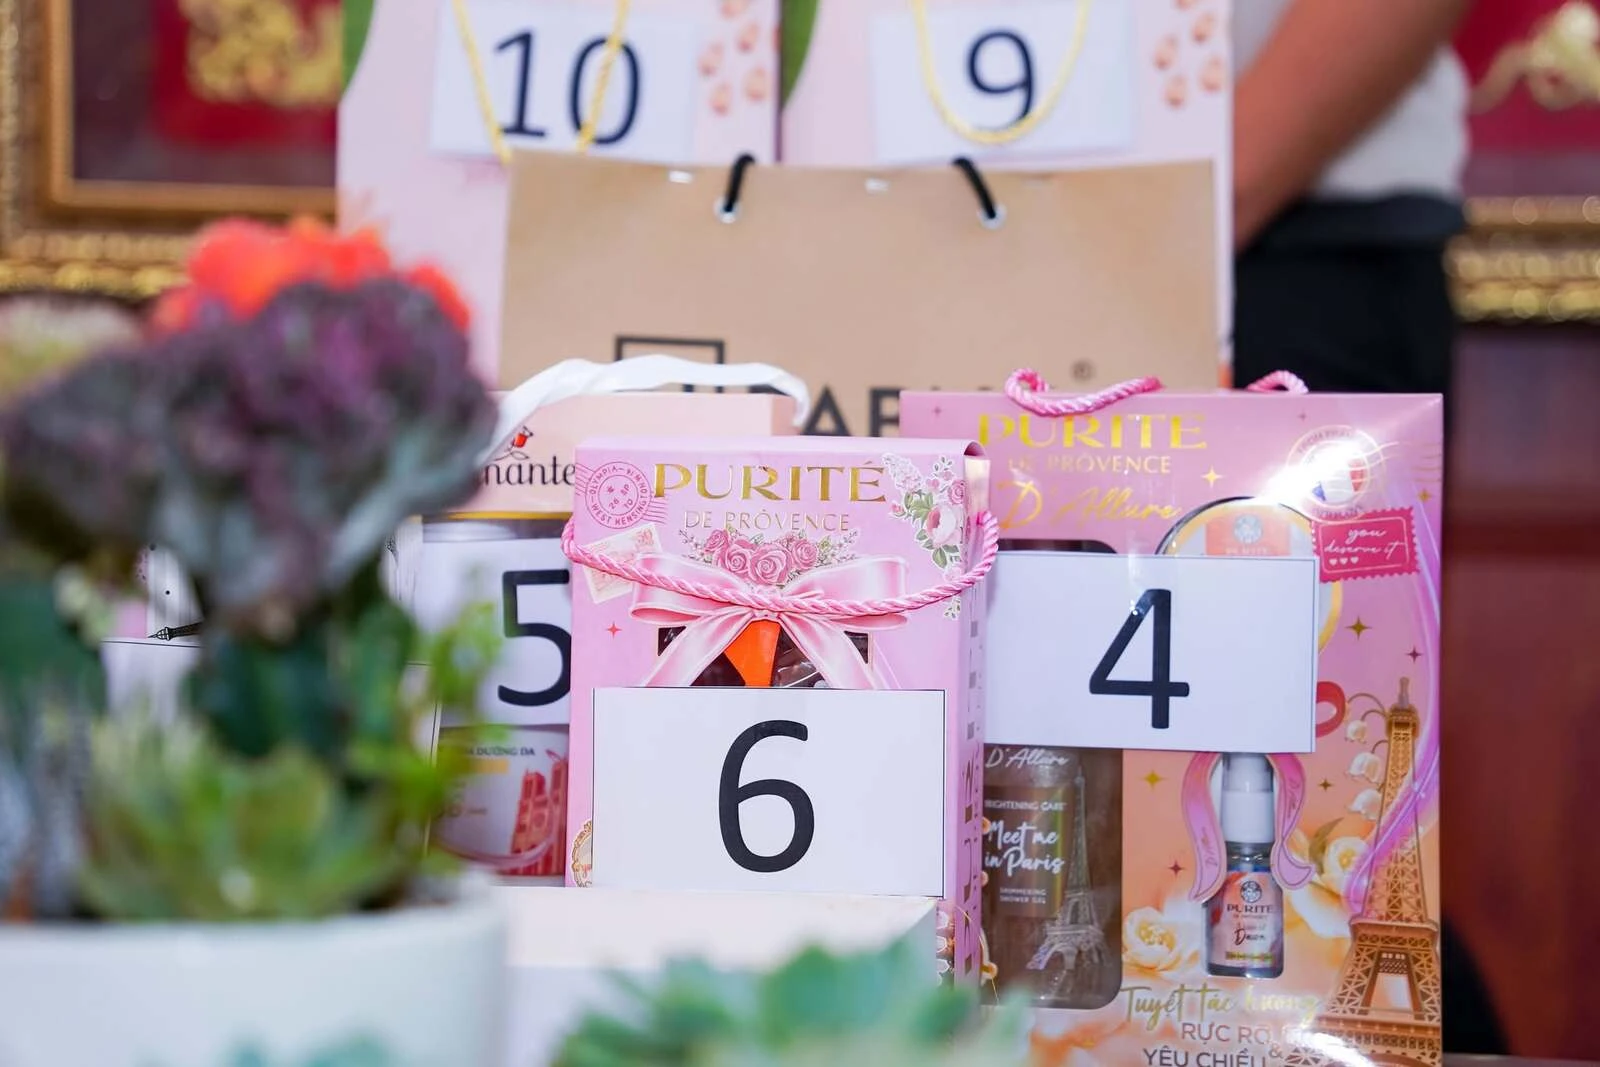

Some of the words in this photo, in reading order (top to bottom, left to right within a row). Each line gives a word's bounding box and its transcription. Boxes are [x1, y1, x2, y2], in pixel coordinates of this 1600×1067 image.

[494, 29, 642, 146] 10
[965, 30, 1037, 131] 9
[655, 461, 887, 502] PURITÉ
[685, 510, 712, 529] DE
[1345, 528, 1387, 544] you
[1323, 540, 1379, 554] deserve
[498, 569, 571, 707] 5
[1088, 588, 1190, 730] 4
[718, 719, 815, 873] 6
[988, 818, 1037, 850] Meet
[1032, 830, 1060, 845] me
[1003, 846, 1065, 877] Paris
